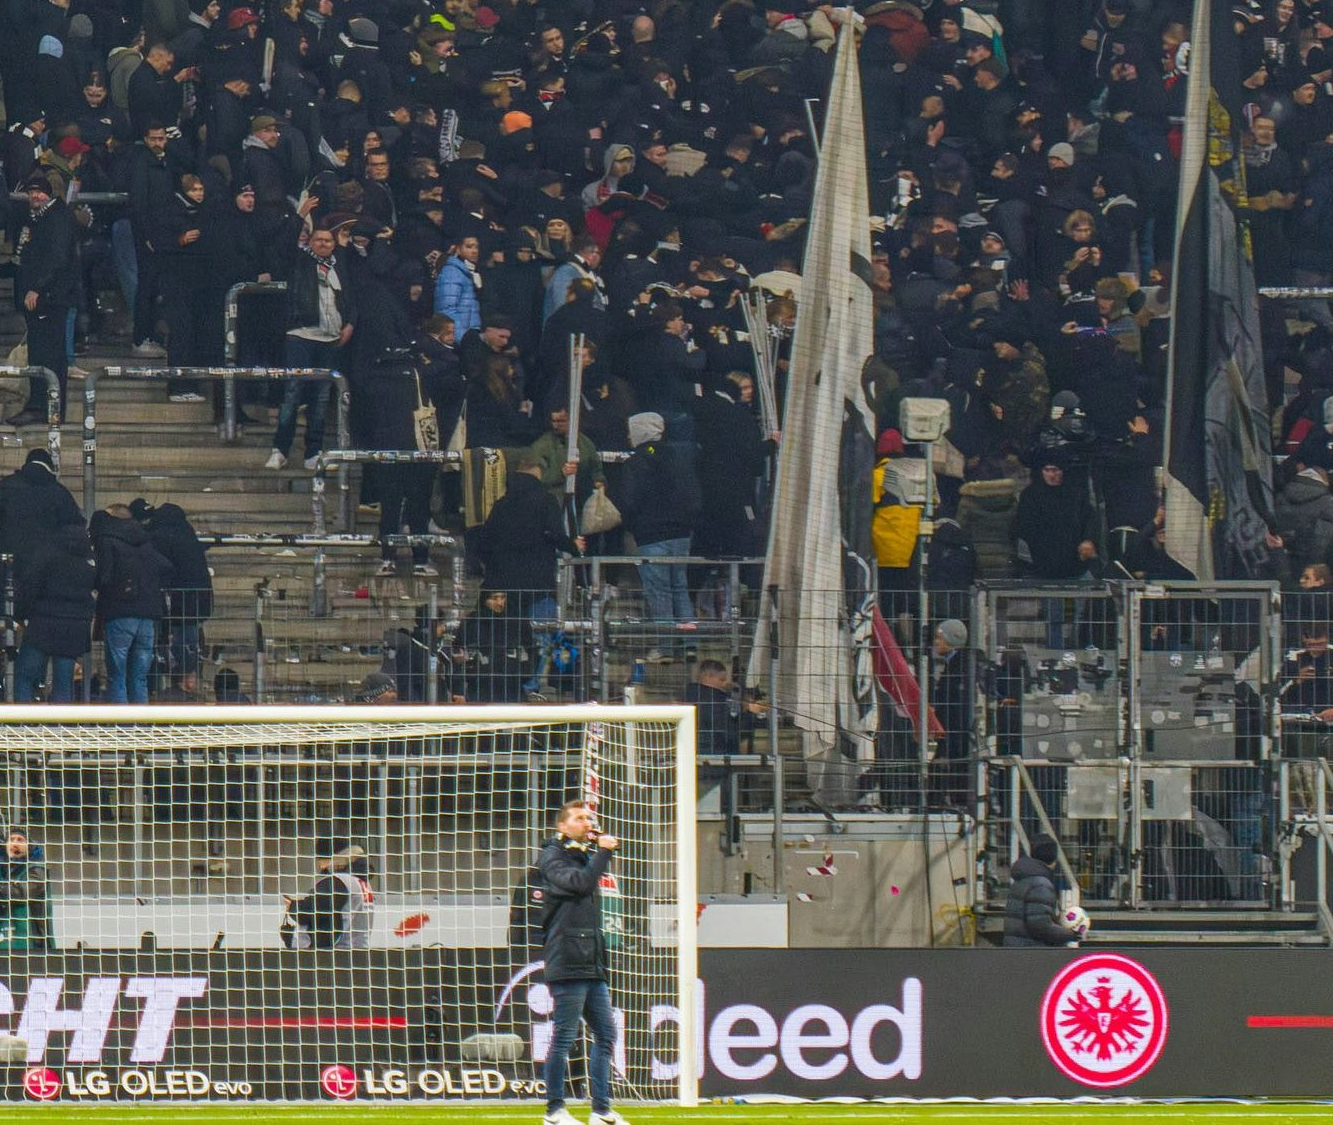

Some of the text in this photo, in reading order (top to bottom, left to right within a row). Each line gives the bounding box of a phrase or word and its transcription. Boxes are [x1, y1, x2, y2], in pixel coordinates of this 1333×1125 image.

[527, 977, 921, 1080] ideed
[66, 1070, 252, 1095] LG OLED evo
[363, 1069, 408, 1094] LG
[418, 1069, 506, 1094] OLED
